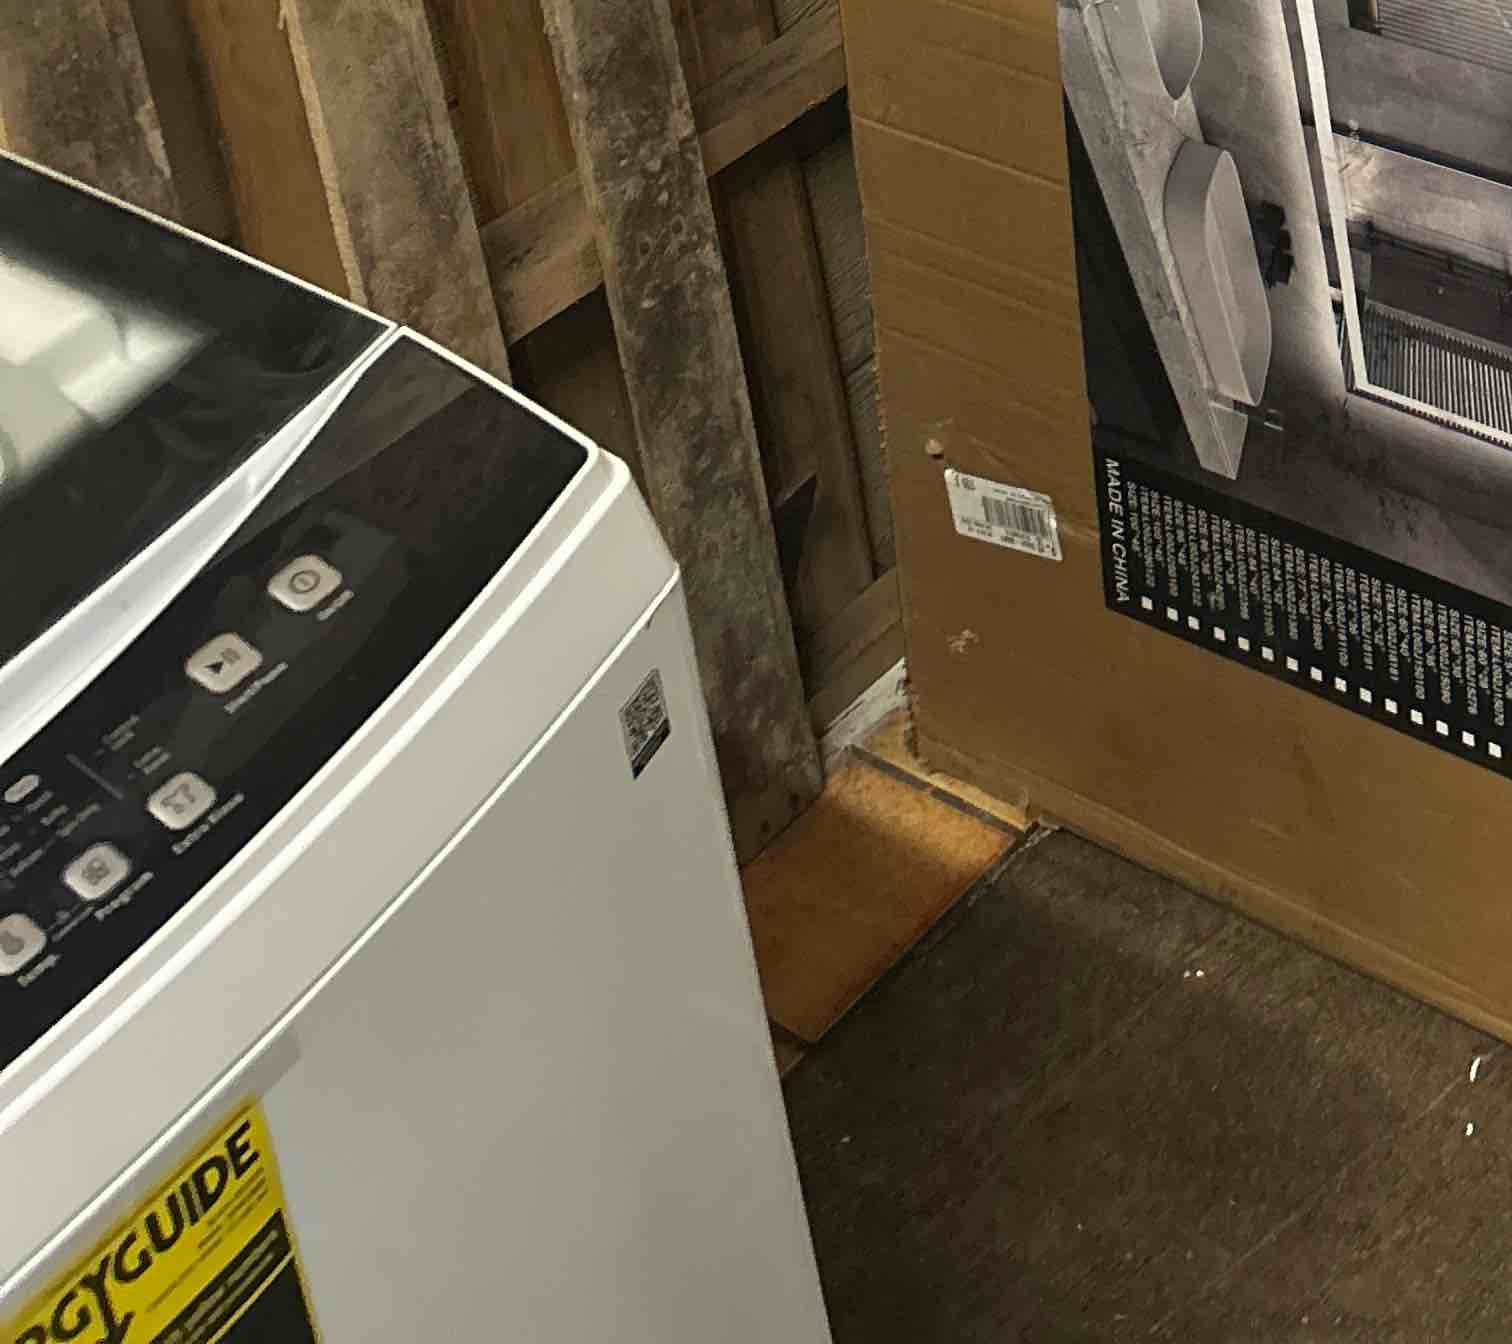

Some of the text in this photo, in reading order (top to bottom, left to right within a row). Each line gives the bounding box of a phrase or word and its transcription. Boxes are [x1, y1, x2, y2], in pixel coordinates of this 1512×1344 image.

[1105, 457, 1130, 602] MADE IN CHINA
